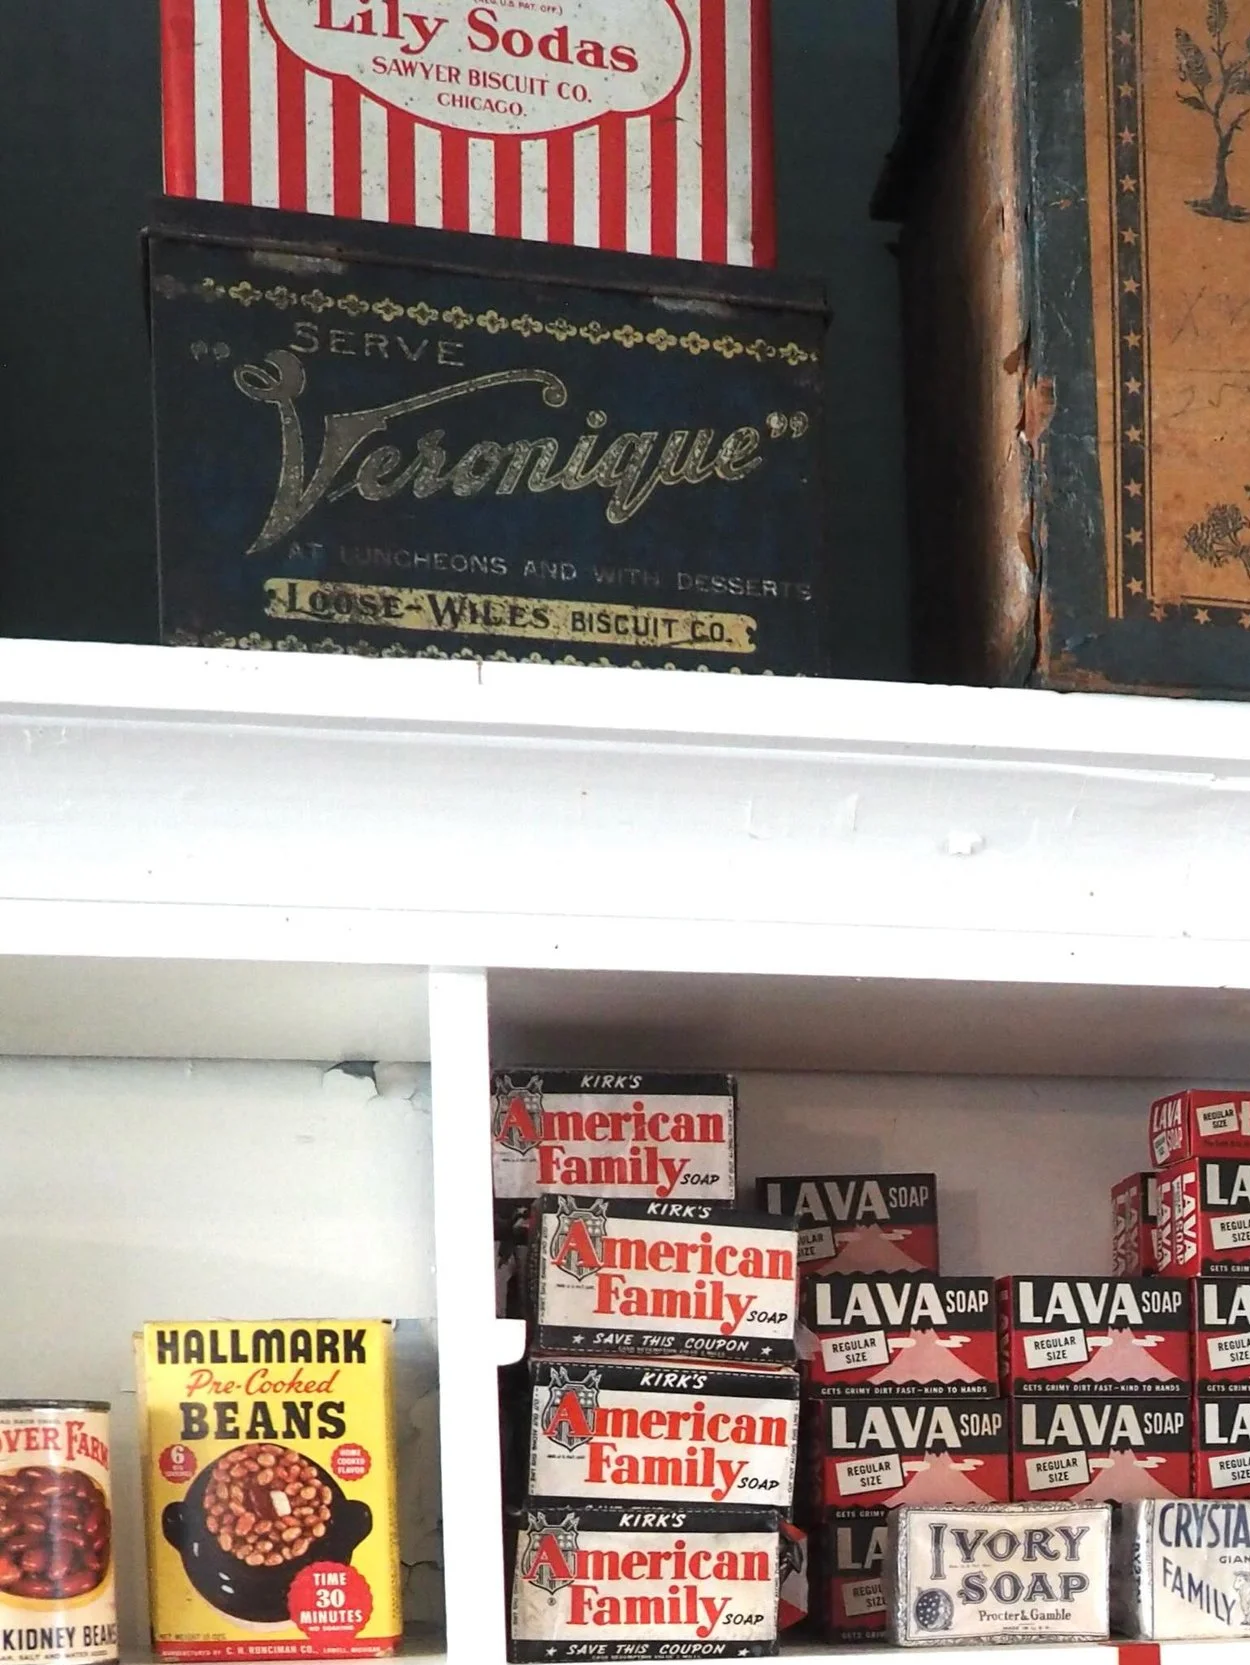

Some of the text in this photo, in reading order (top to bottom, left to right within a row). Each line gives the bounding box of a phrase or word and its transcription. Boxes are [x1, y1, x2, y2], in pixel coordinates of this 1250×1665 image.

[466, 10, 639, 73] Sodas
[372, 55, 592, 103] SAWYER BISCUIT CO.
[438, 93, 527, 116] CHICAGO.
[290, 322, 465, 366] SERVE
[570, 612, 677, 640] BISCUIT
[691, 621, 733, 644] CO.
[647, 1203, 712, 1218] KIRK'S
[551, 1220, 793, 1280] American
[1233, 1232, 1250, 1242] SIZE
[593, 1273, 788, 1335] Family SOAP
[157, 1329, 366, 1364] HALLMARK
[594, 1333, 749, 1351] SAVE THIS COUPON
[187, 1369, 340, 1397] Pre-Cooked
[180, 1402, 346, 1440] BEANS
[929, 1523, 1089, 1580] IVORY
[313, 1573, 347, 1586] TIME
[958, 1572, 1089, 1605] SOAP
[1163, 1558, 1236, 1624] FAMILY
[316, 1589, 345, 1607] 30
[300, 1610, 363, 1624] MINUTES
